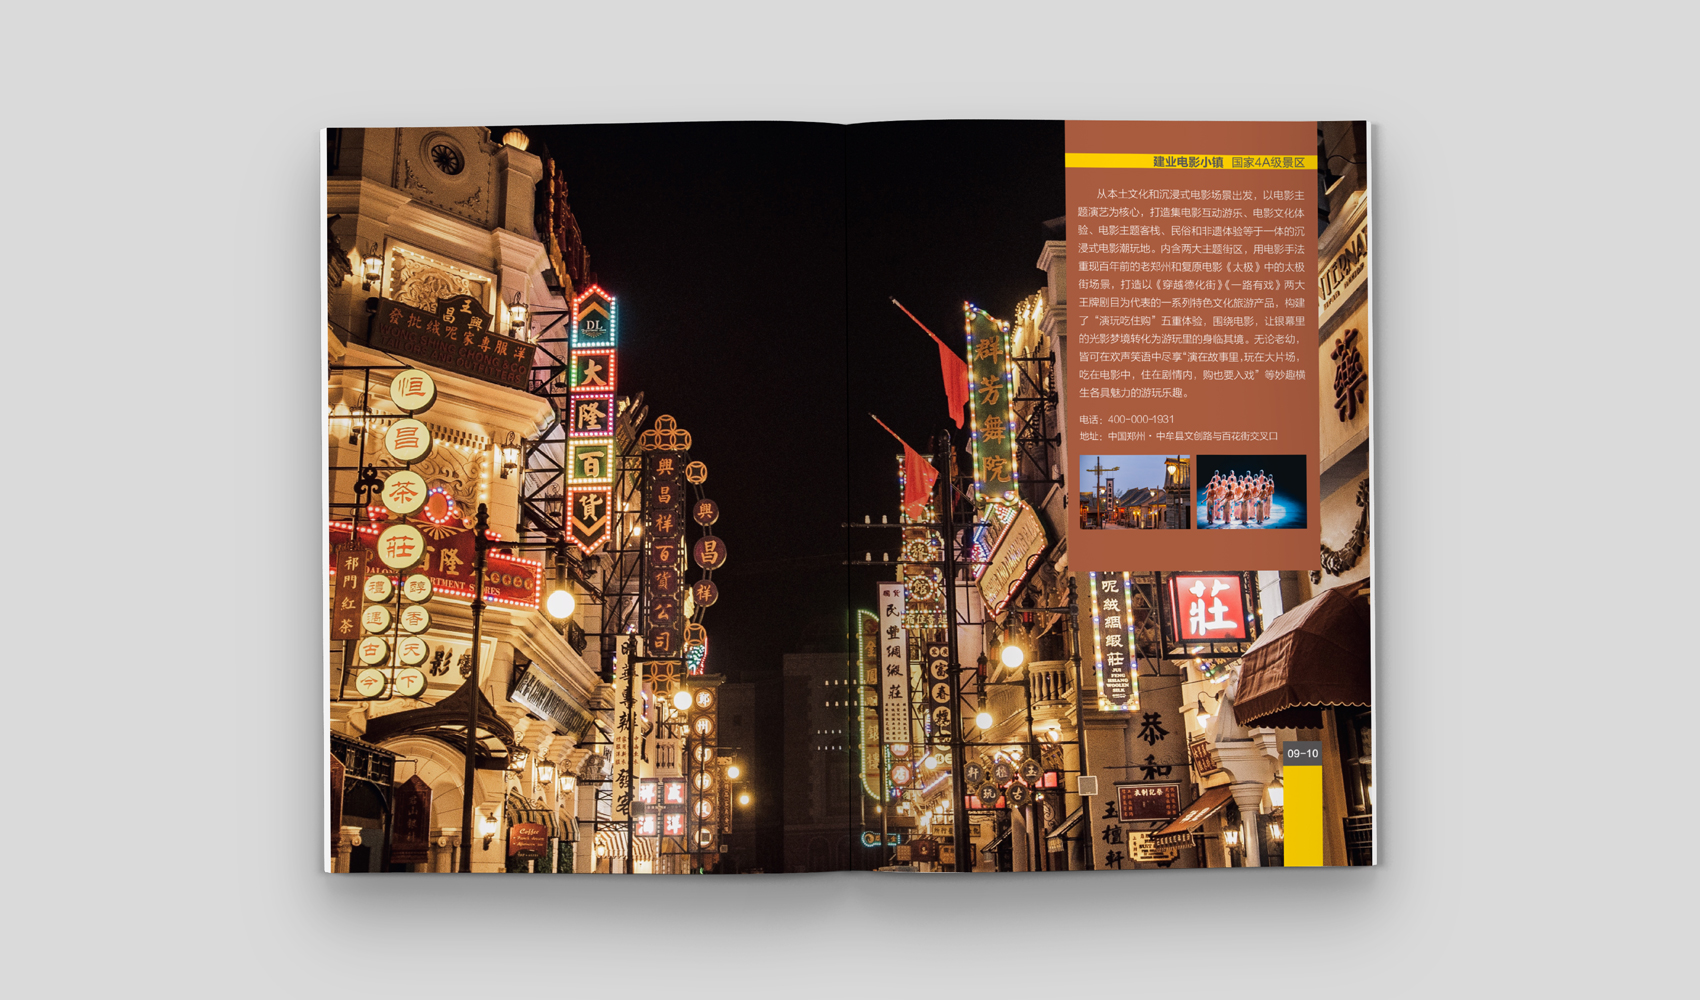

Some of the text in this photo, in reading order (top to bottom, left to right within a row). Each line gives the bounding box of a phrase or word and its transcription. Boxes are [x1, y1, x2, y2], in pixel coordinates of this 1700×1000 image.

[1153, 156, 1306, 169] 建业电影小镇 国家4A级景区
[1096, 188, 1305, 201] 从本土文化和沉浸式电影场景出发，以电影主
[1077, 206, 1305, 219] 题演艺为核心，打造集电影互动游乐、电影文化体
[1077, 224, 1306, 237] 验、电影主题客栈、民俗和非遗体验等于一体的沉
[1077, 242, 1305, 255] 浸式电影潮玩地。内含两大主题街区，用电影手法
[1078, 260, 1306, 273] 重现百年前的老郑州和复原电影《太极》中的太极
[1078, 278, 1306, 291] 街场景，打造以《穿越德化街》《一路有戏》两大
[1078, 296, 1306, 309] 王牌剧目为代表的一系列特色文化旅游产品，构建
[586, 320, 603, 330] DL
[380, 323, 417, 343] WONG
[421, 335, 457, 353] SHING
[458, 347, 500, 367] CHONG
[1078, 332, 1300, 345] 的光影梦境转化为游玩里的身临其境。无论老幼，
[380, 336, 522, 384] TAILORS AND OUTFITTERS
[1330, 328, 1367, 423] 藥
[1079, 387, 1188, 399] 生各具魅力的游玩乐趣。
[975, 337, 1011, 484] 群芳舞院
[577, 358, 607, 521] 大隆百貨
[654, 458, 674, 651] 興昌祥百貨公司
[697, 503, 719, 600] 興昌祥
[339, 556, 359, 635] 祁門紅茶
[469, 583, 501, 595] SRES
[1189, 578, 1238, 636] 莊
[1286, 748, 1319, 759] 09-10
